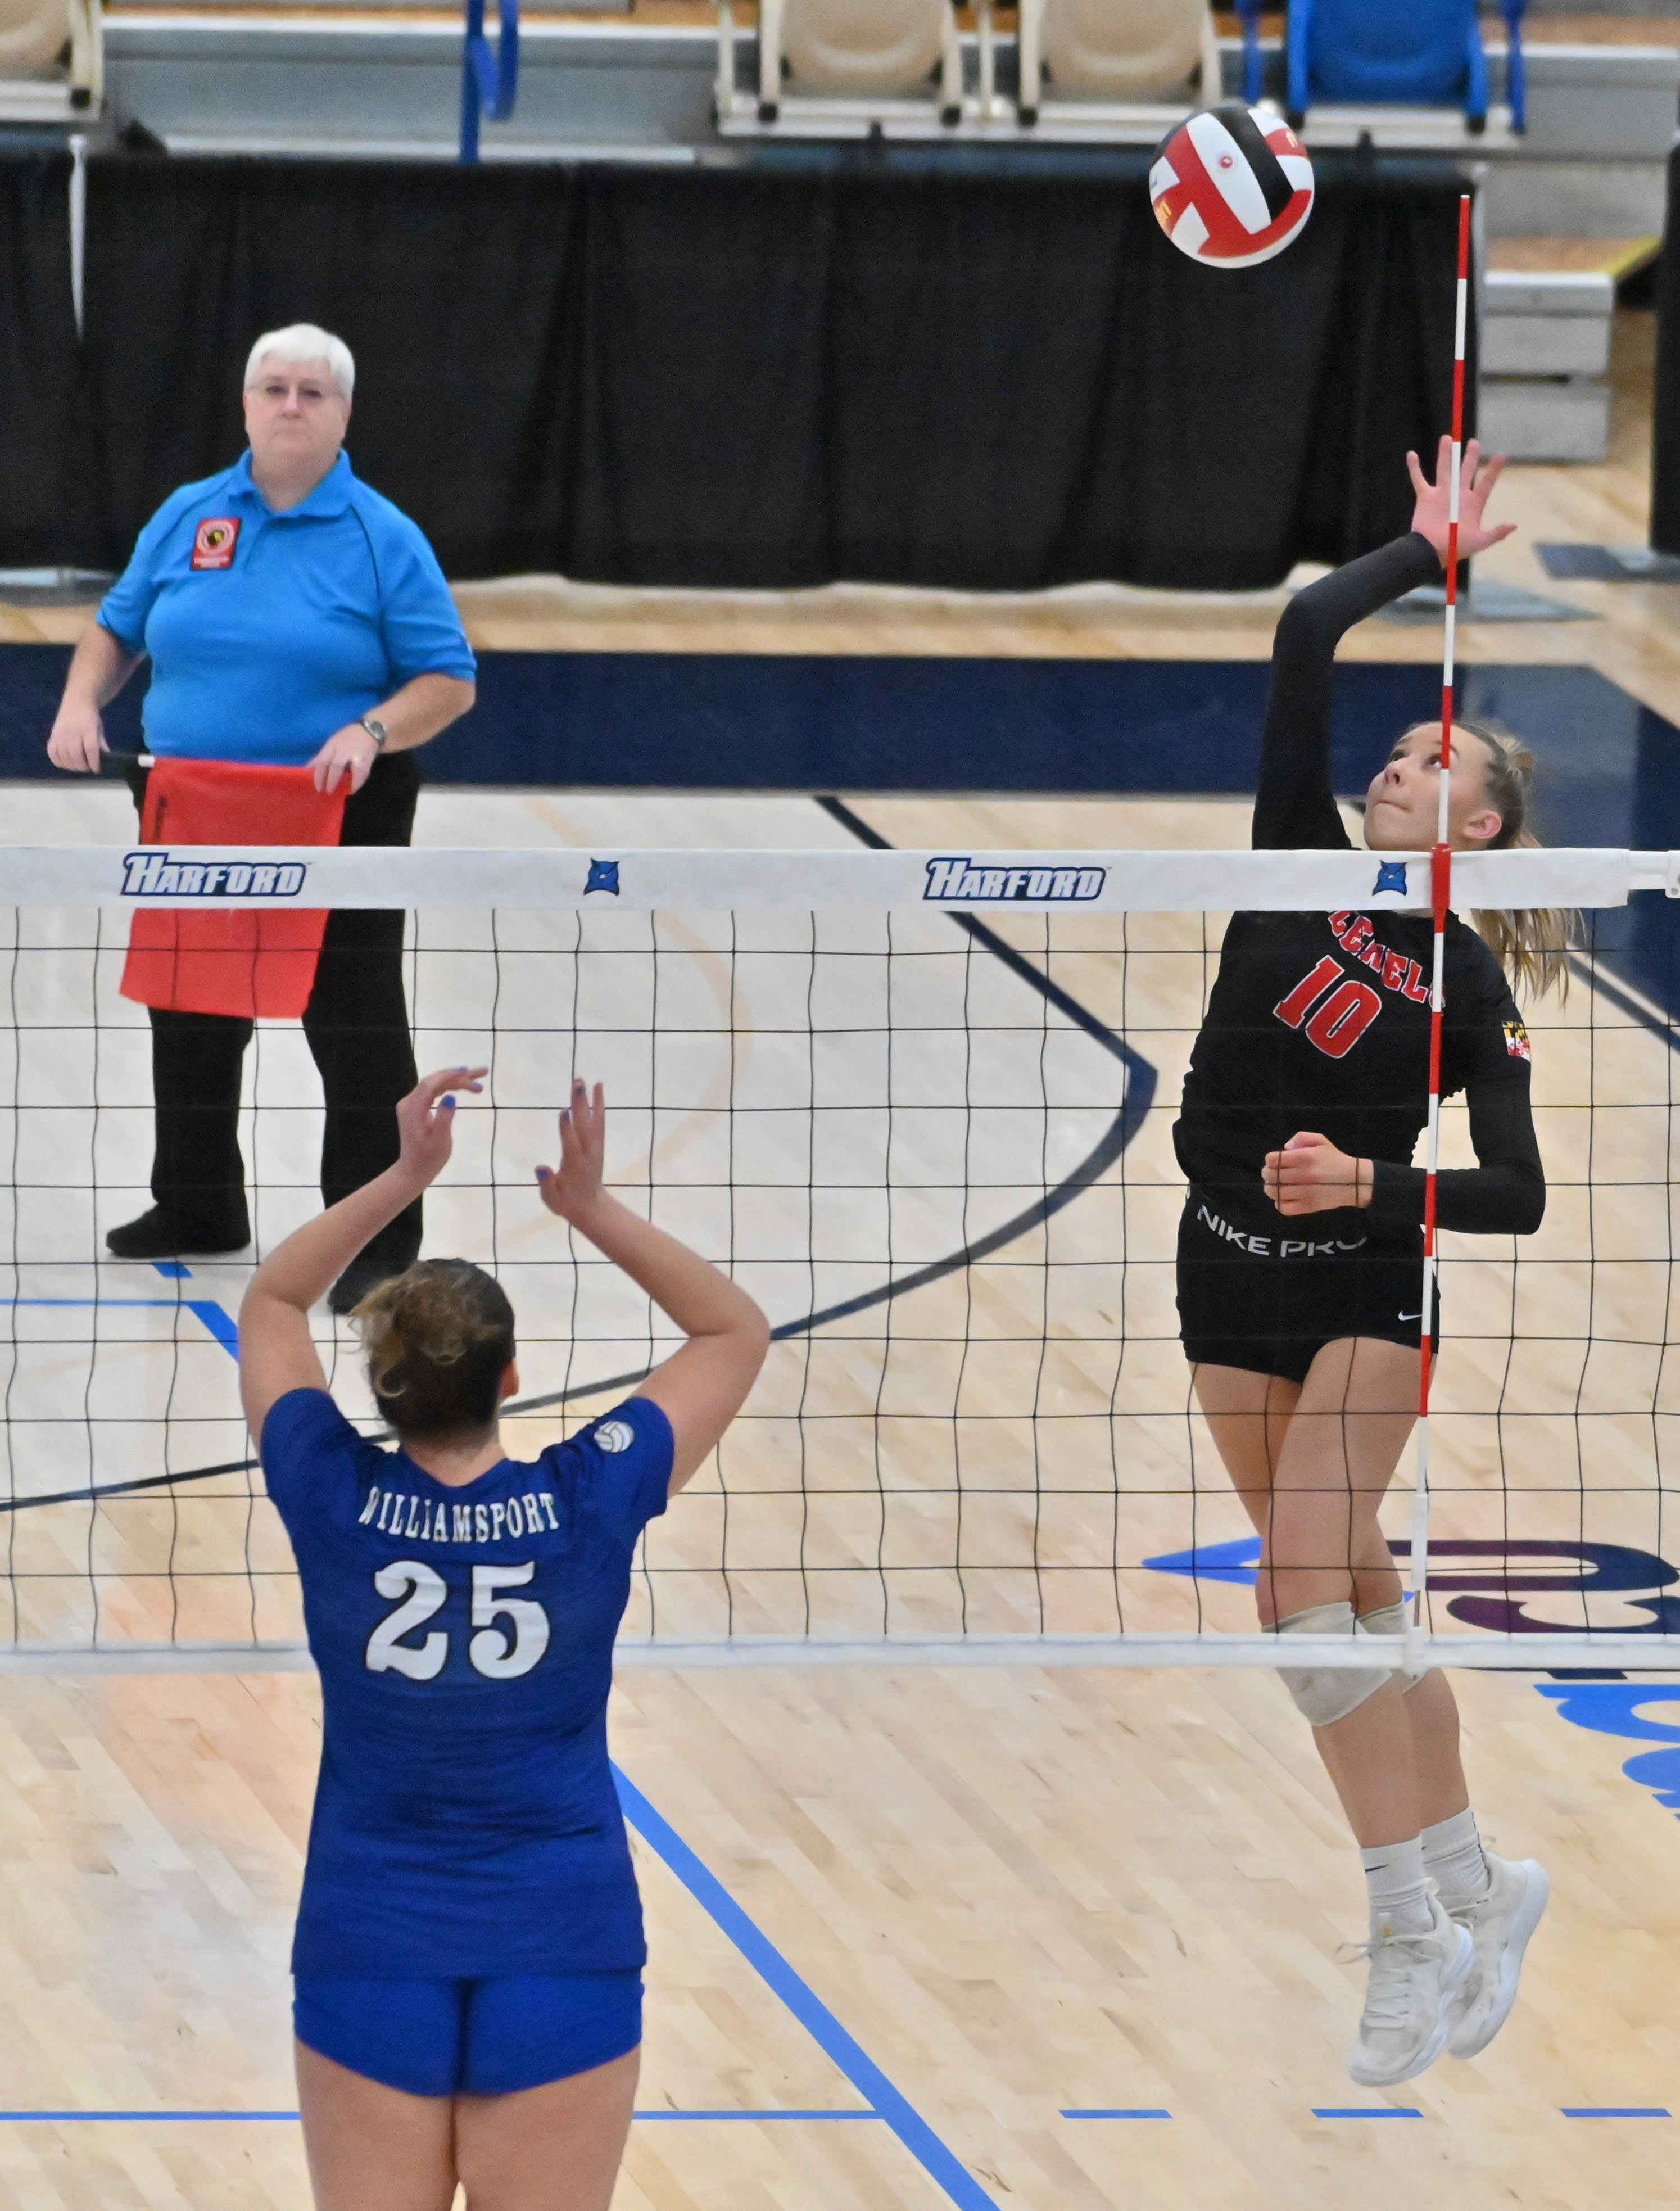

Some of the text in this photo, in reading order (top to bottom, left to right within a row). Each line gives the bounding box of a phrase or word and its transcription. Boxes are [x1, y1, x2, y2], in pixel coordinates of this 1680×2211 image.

[1273, 954, 1382, 1059] 10
[1197, 1204, 1271, 1256] NIKE
[365, 1559, 550, 1680] 25
